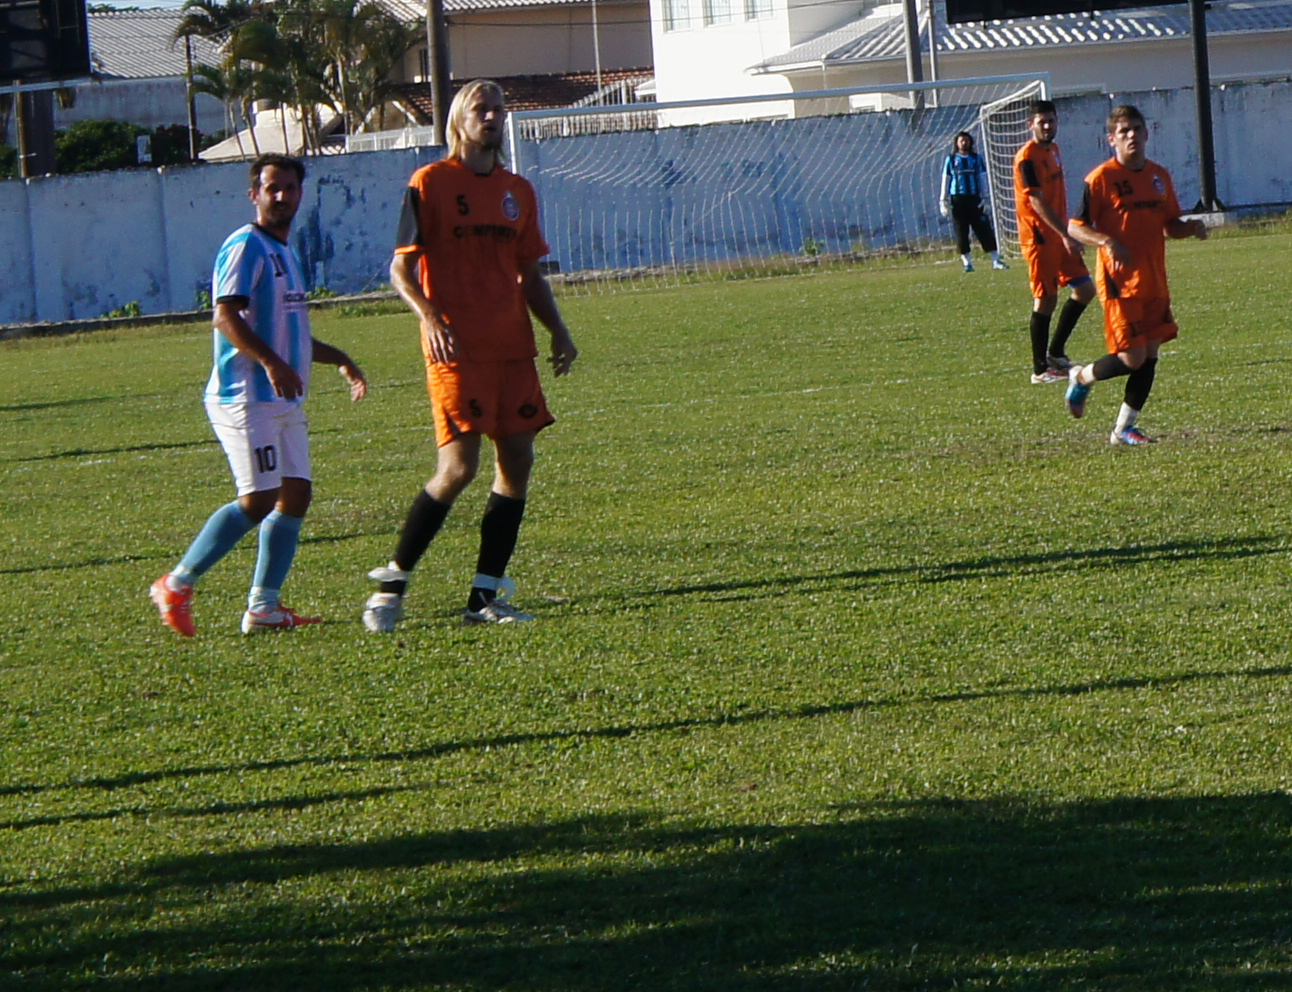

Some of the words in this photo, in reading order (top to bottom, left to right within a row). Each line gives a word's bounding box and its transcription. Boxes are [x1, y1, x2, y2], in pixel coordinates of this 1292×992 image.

[457, 194, 470, 216] 5
[469, 398, 483, 418] 5
[254, 444, 277, 474] 10
